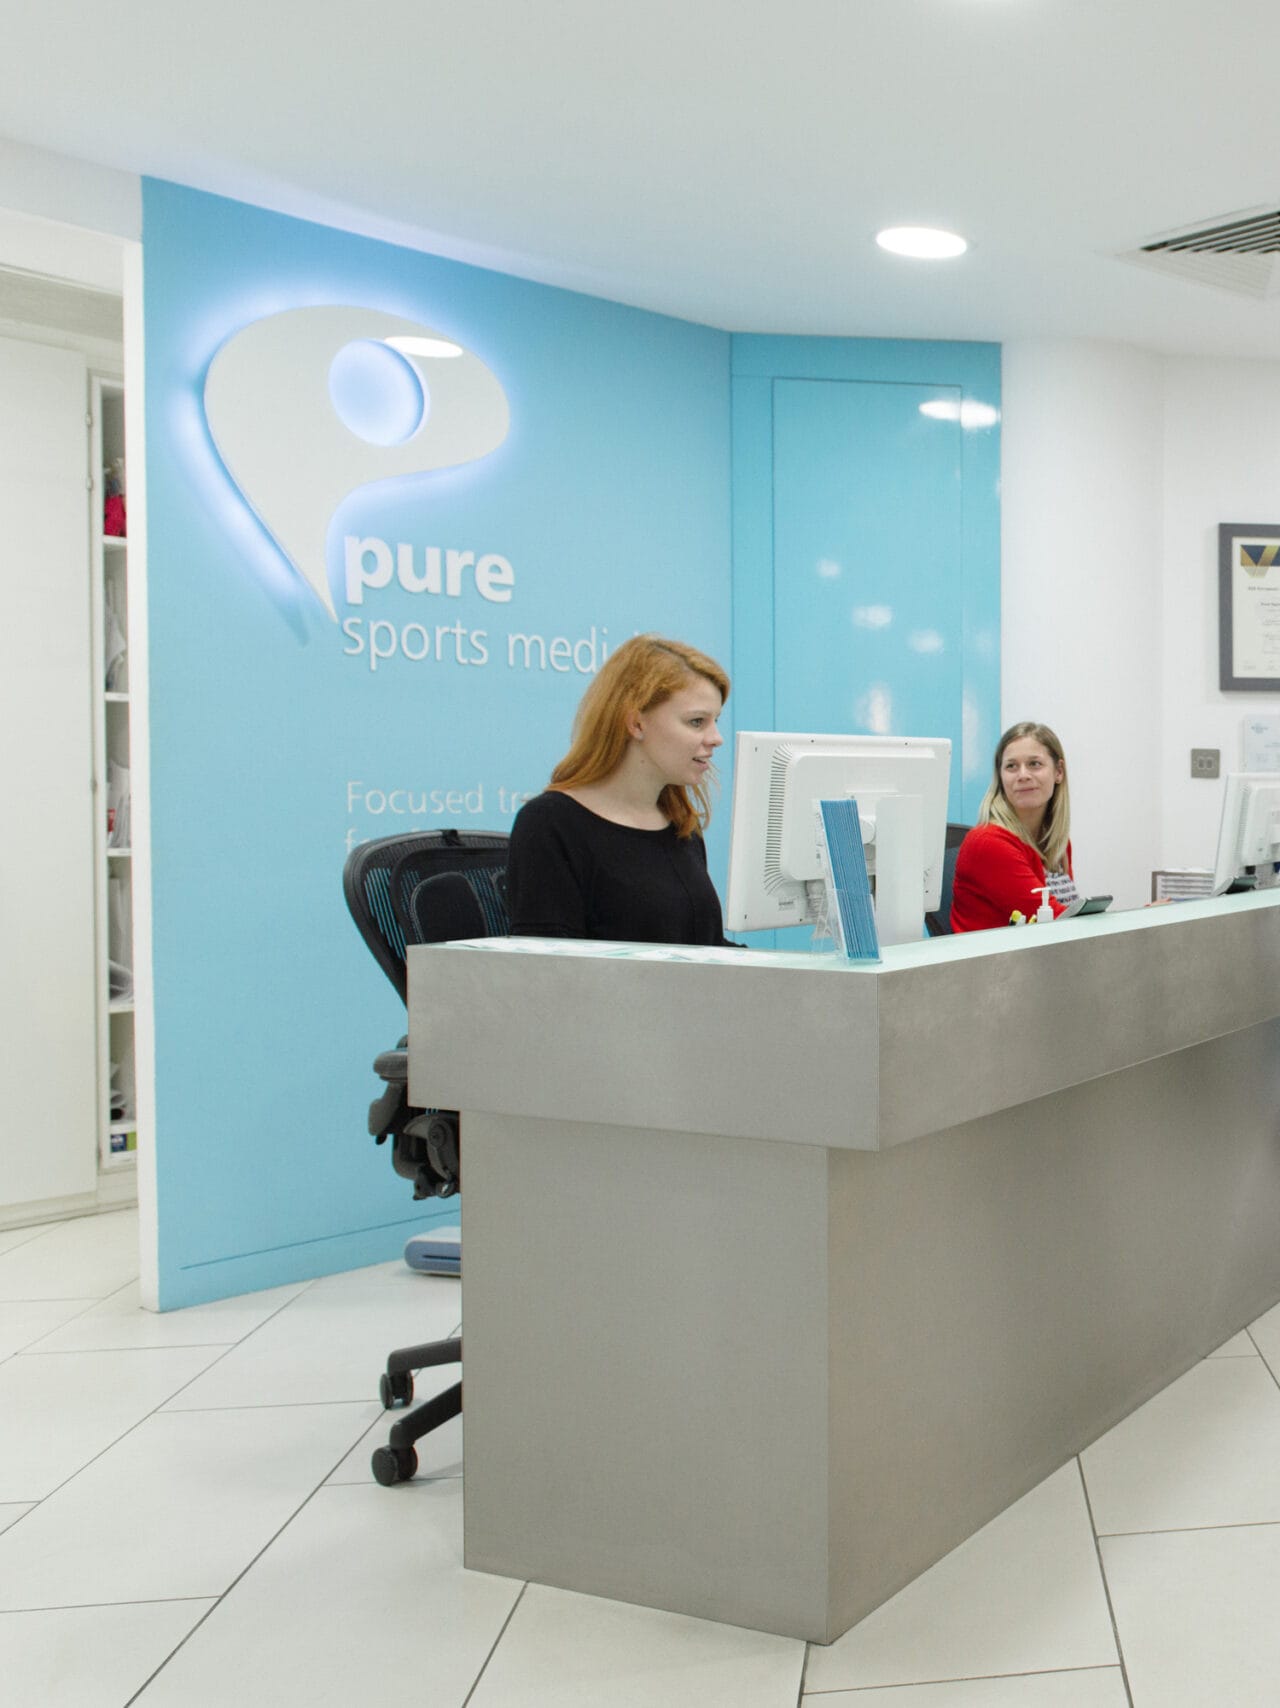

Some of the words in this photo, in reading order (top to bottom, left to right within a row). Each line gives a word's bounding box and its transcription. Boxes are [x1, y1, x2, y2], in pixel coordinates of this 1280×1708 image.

[344, 535, 515, 605] pure
[342, 616, 489, 671] sports
[507, 625, 612, 673] medi
[347, 781, 484, 815] Focused
